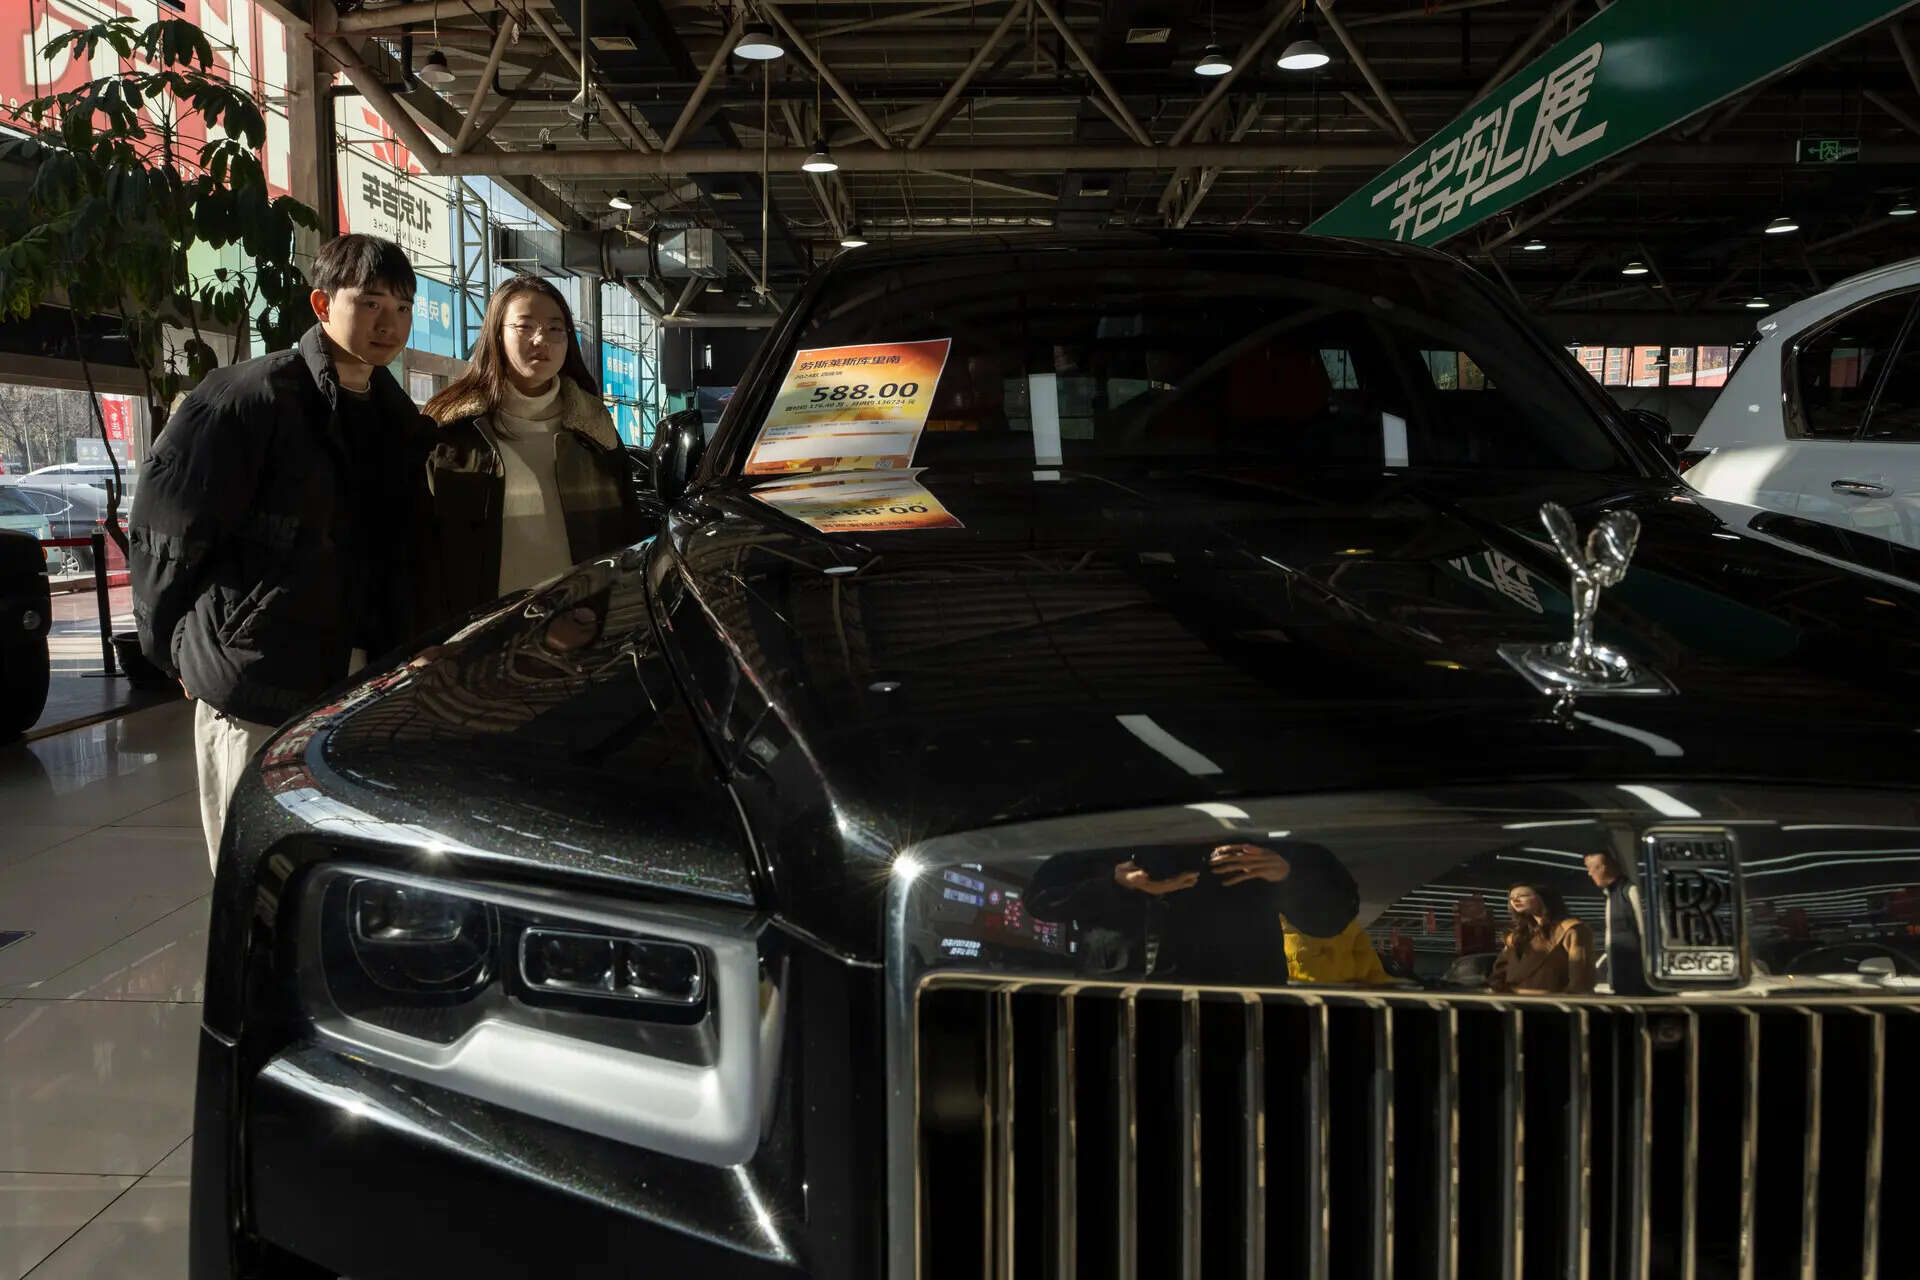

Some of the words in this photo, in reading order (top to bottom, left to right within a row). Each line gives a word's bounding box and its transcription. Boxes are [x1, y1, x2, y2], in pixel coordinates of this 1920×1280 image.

[799, 355, 902, 371] 劳斯莱斯库里南
[810, 382, 919, 403] 588.00
